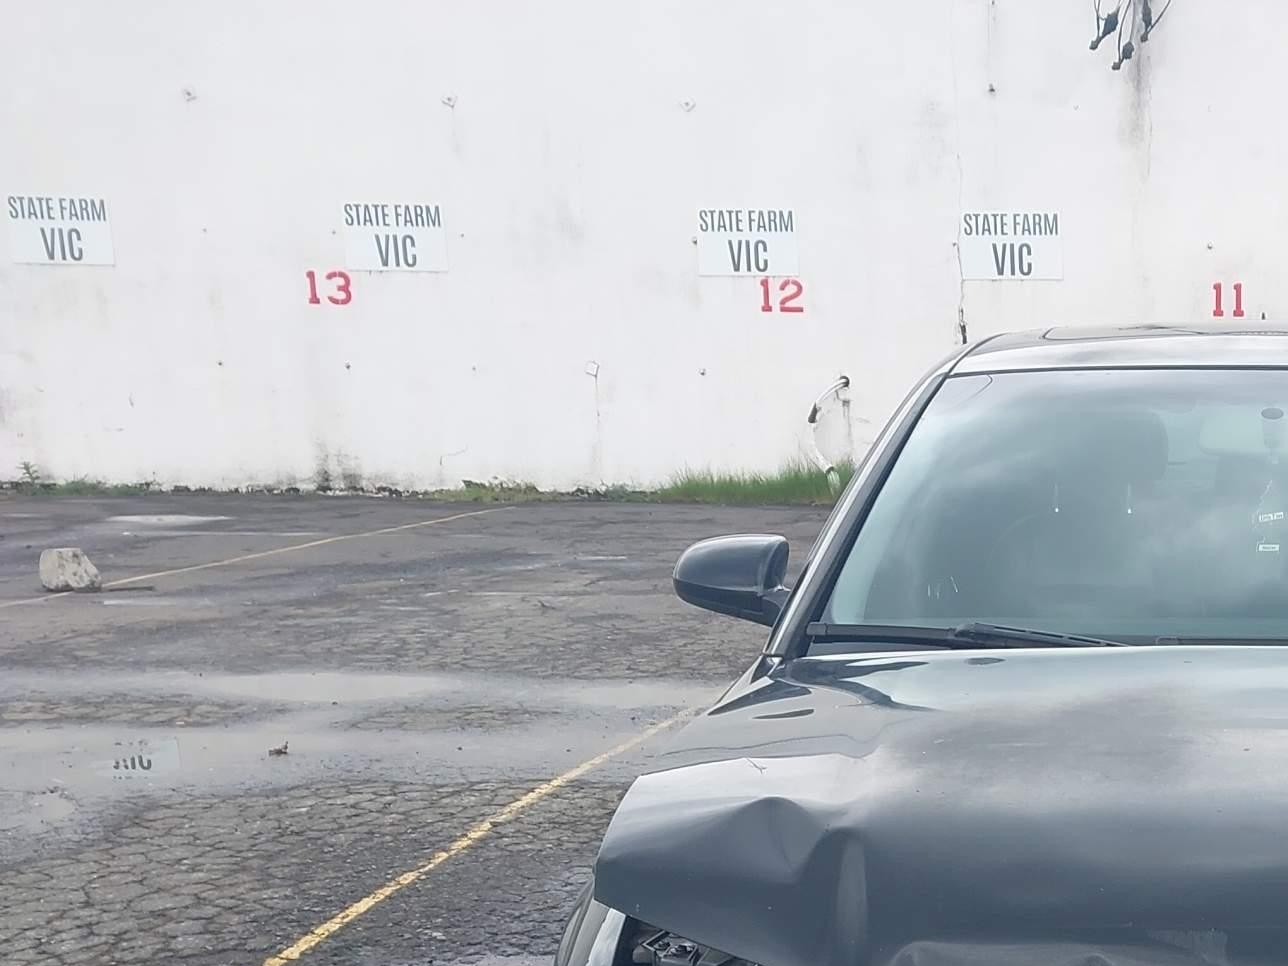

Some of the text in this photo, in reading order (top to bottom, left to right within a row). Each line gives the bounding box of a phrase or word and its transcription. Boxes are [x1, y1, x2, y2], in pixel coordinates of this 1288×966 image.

[7, 195, 106, 222] STATE FARM
[343, 203, 442, 228] STATE FARM
[699, 209, 794, 233] STATE FARM
[963, 213, 1059, 236] STATE FARM
[39, 226, 84, 262] VIC
[374, 234, 417, 268] VIC
[727, 239, 769, 273] VIC
[991, 242, 1032, 276] VIC
[305, 270, 353, 305] 13
[760, 277, 804, 313] 12
[1212, 282, 1245, 318] 11
